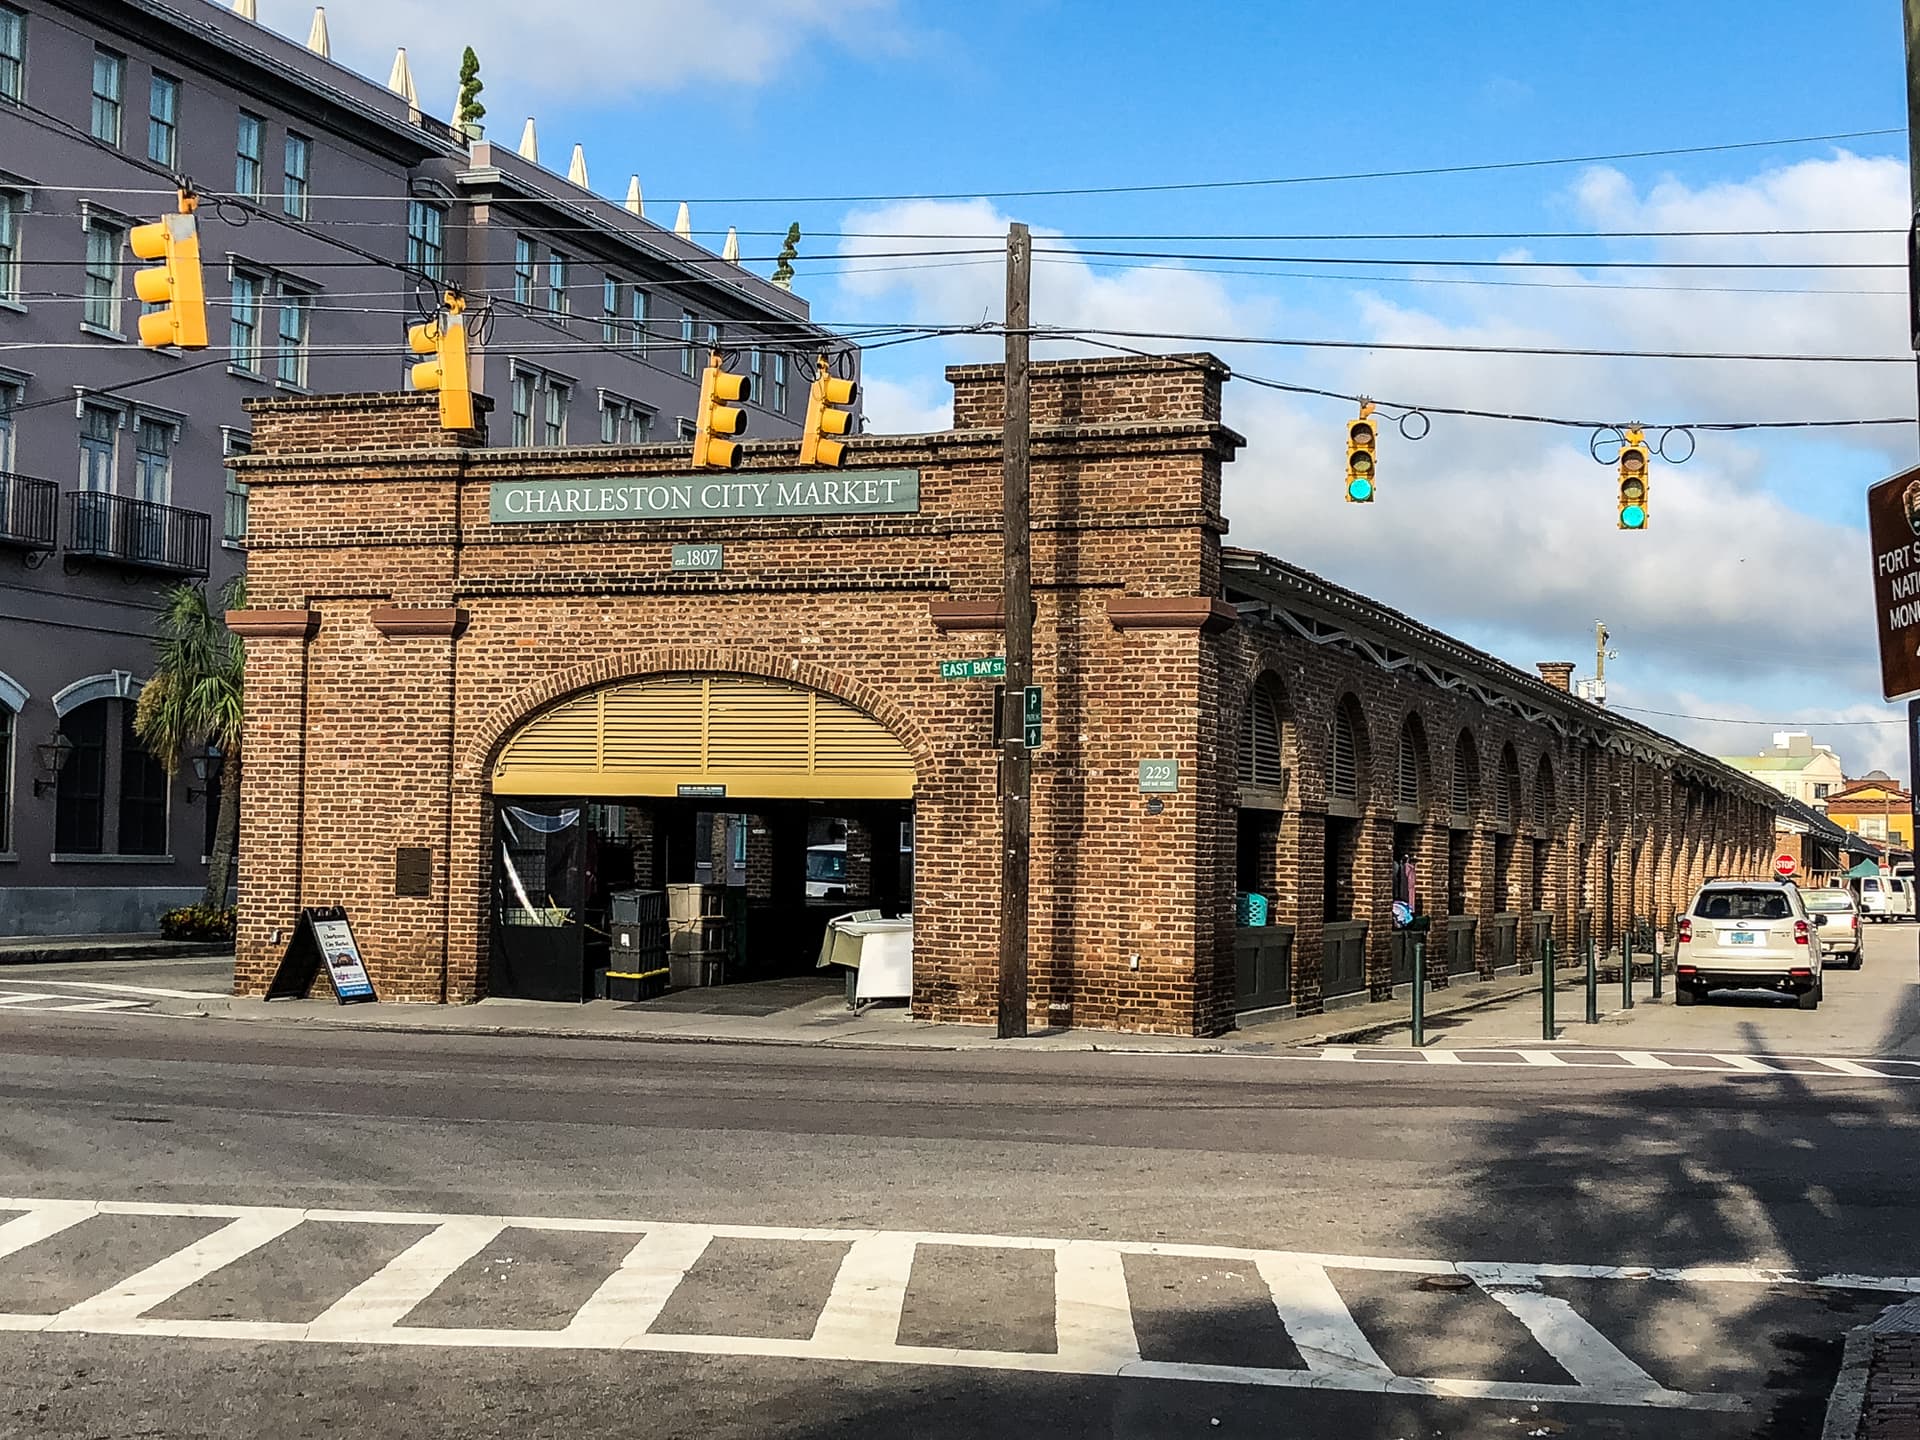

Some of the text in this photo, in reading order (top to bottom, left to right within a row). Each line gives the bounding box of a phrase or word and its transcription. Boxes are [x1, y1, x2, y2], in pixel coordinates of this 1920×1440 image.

[505, 479, 900, 513] CHARLESTON CITY MARKET
[687, 549, 718, 566] 1807
[1879, 545, 1910, 577] FORT
[1892, 571, 1920, 601] NATI
[942, 662, 968, 677] EAST
[973, 661, 992, 675] BAY
[1146, 766, 1170, 780] 229
[1775, 860, 1795, 869] STOP
